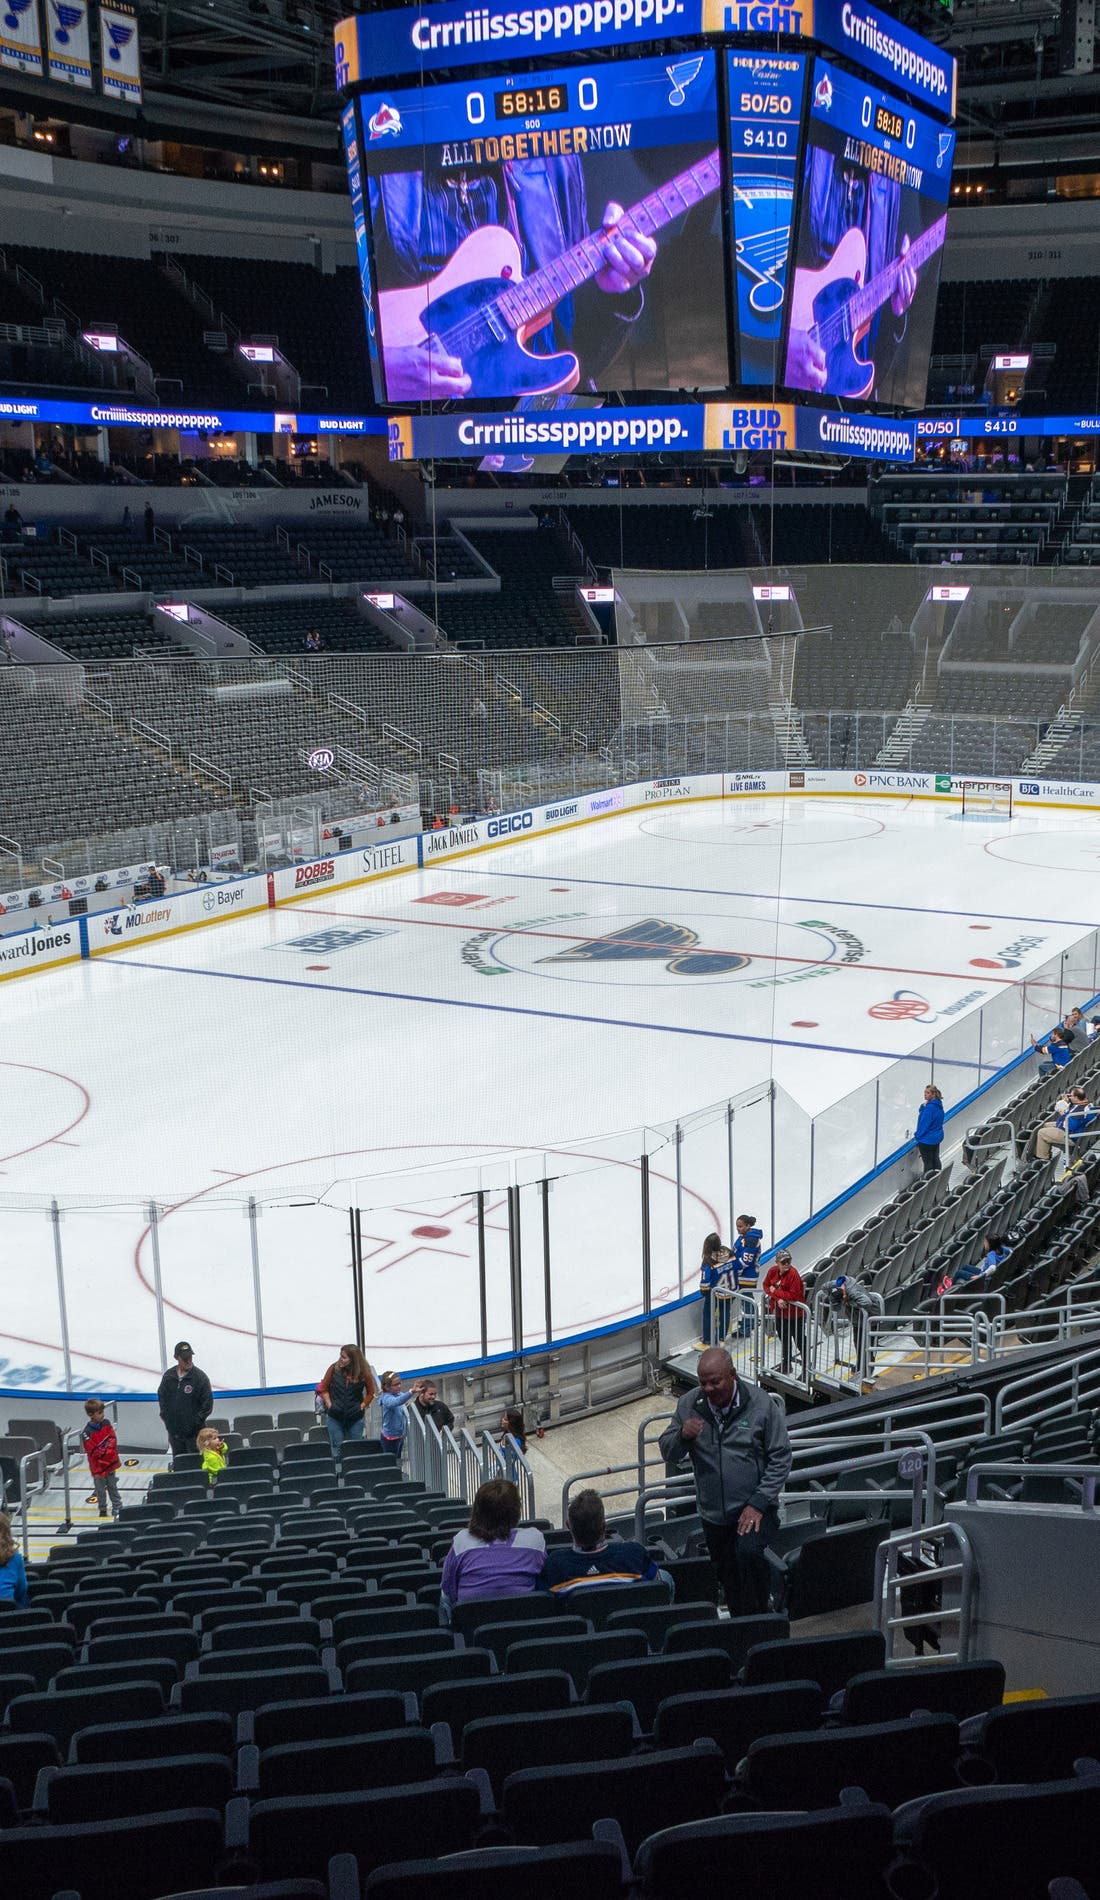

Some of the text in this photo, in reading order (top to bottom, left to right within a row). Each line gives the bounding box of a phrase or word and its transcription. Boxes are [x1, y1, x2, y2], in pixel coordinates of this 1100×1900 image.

[724, 6, 803, 34] LIGHT
[733, 57, 799, 71] HOLLYWOOD
[502, 88, 561, 115] 58:16
[578, 78, 598, 111] 0
[741, 93, 792, 114] 50/50
[466, 92, 485, 124] 0
[861, 96, 872, 127] 0
[877, 109, 902, 139] 58:16
[743, 128, 787, 148] $410
[906, 119, 916, 149] 0
[13, 404, 37, 415] LIGHT
[733, 409, 781, 428] BUD
[320, 420, 363, 430] BUD LIGHT
[917, 422, 954, 434] 50/50
[984, 421, 1017, 432] $410
[723, 430, 787, 450] LIGHT
[310, 494, 361, 510] JAMESON
[313, 754, 330, 768] KIA
[644, 787, 691, 801] PRO PLAN
[730, 781, 766, 791] LIVE GAMES
[940, 780, 1010, 792] enterprise
[1021, 784, 1039, 794] BJC
[1043, 786, 1095, 798] HealthCare
[546, 804, 577, 820] BUD LIGHT
[590, 798, 613, 812] Walmart
[487, 812, 533, 838] GEICO
[428, 834, 447, 853] JACK
[363, 846, 404, 873] STIFEL
[296, 860, 335, 882] DOBBS
[217, 887, 244, 905] Bayer
[285, 930, 350, 947] BUD
[301, 929, 384, 953] LIGHT
[937, 990, 987, 1015] Insurance
[743, 1252, 755, 1263] 55
[717, 1270, 737, 1291] 41
[901, 1459, 922, 1473] 120
